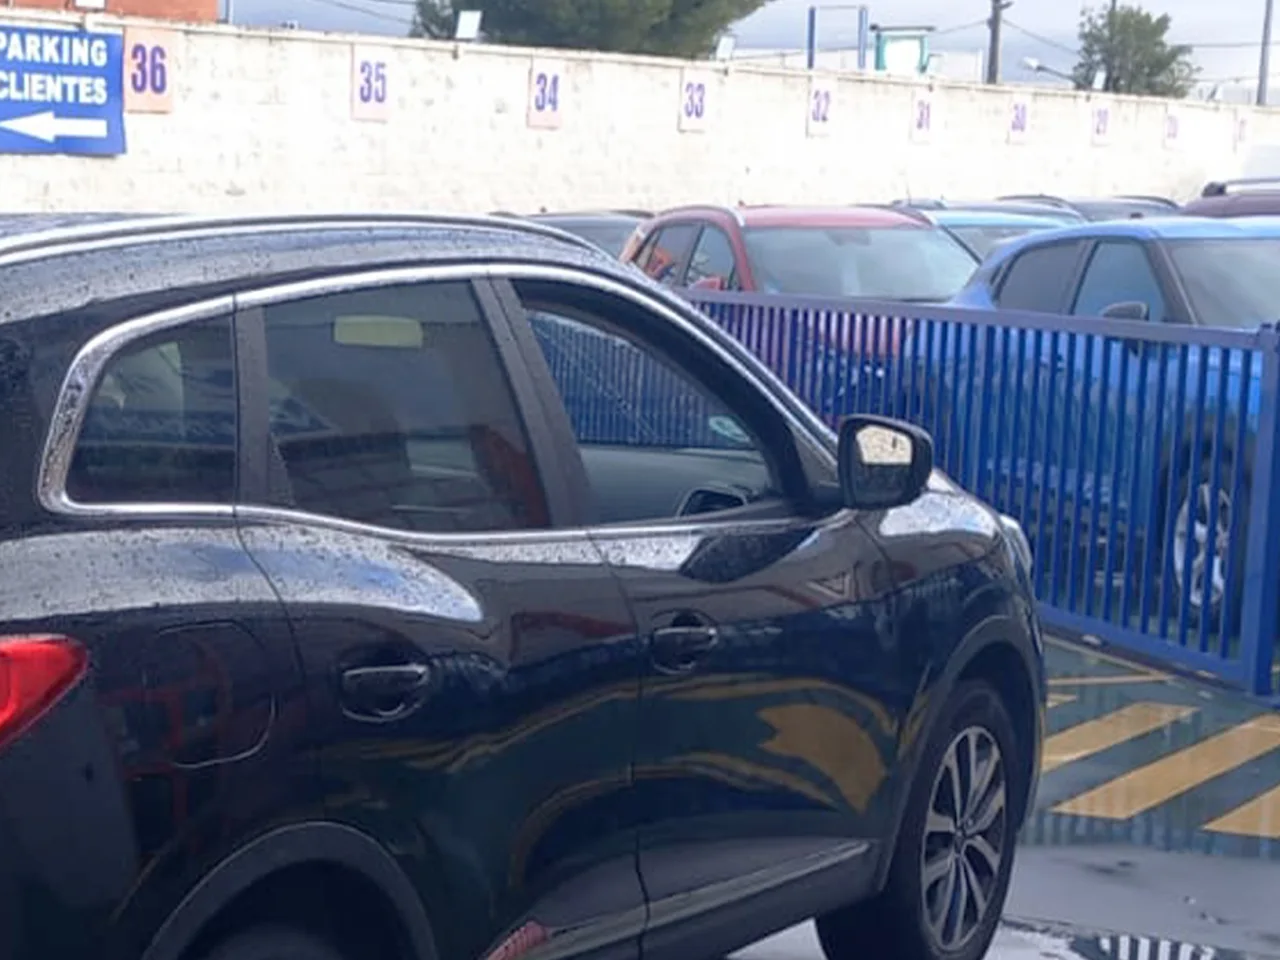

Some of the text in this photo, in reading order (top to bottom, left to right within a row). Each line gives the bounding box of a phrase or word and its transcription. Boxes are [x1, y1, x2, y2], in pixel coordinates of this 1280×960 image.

[131, 44, 167, 94] 36
[359, 61, 387, 104] 35
[535, 73, 559, 112] 34
[684, 82, 706, 119] 33
